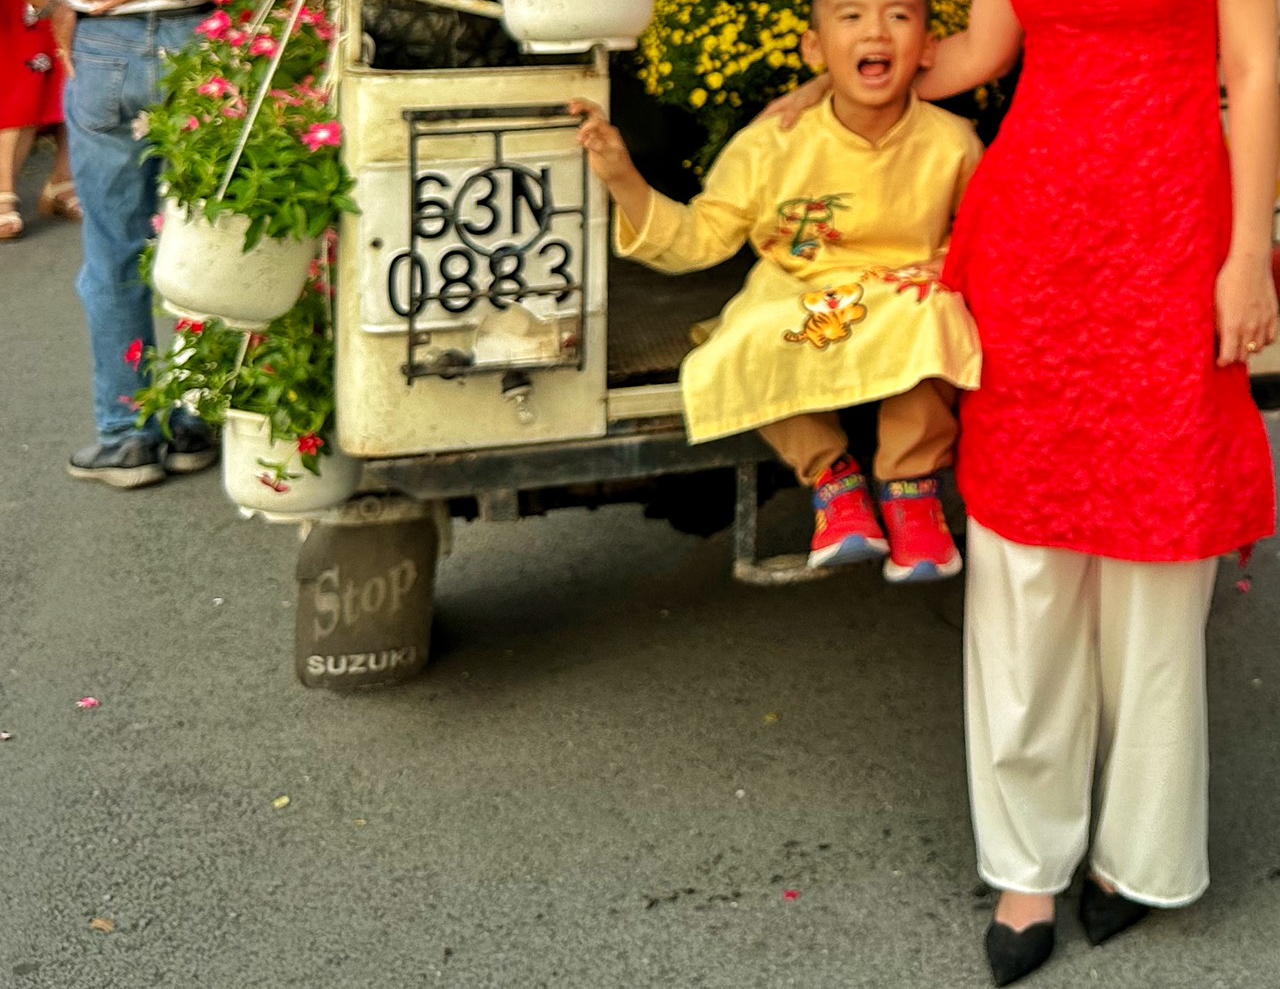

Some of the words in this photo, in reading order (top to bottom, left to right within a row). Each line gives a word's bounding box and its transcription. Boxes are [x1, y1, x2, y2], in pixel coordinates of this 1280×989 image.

[413, 165, 551, 239] 63N
[387, 241, 573, 317] 0883
[306, 646, 417, 675] SUZUKI
